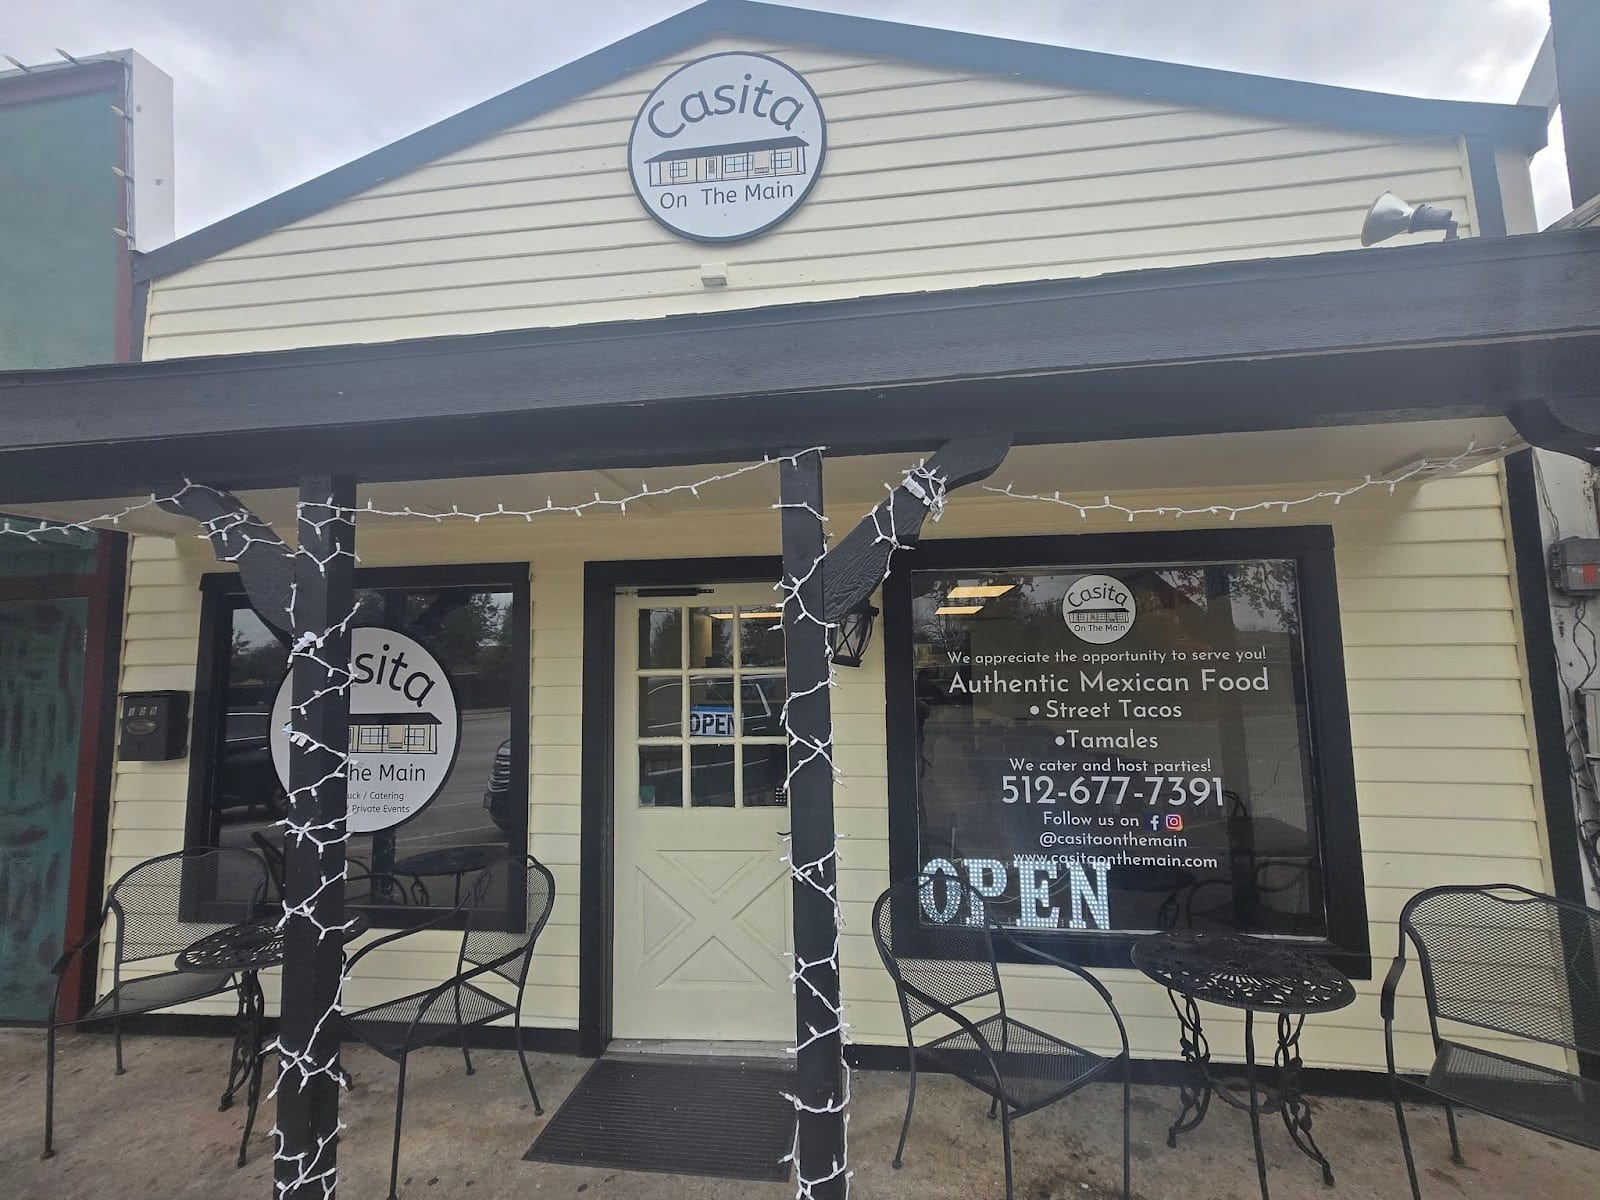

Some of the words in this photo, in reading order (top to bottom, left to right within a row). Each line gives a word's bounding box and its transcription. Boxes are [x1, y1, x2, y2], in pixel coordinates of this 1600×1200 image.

[648, 73, 804, 138] Casita
[660, 192, 687, 209] On
[701, 186, 738, 205] The
[745, 181, 793, 201] Main
[1068, 583, 1128, 607] Casita
[1074, 624, 1086, 632] On
[1088, 624, 1103, 632] The
[1105, 624, 1126, 632] Main
[947, 651, 970, 664] We
[975, 652, 1050, 666] appreciate
[1054, 649, 1078, 662] the
[1082, 649, 1167, 665] opportunity
[1171, 650, 1187, 661] to
[1192, 651, 1231, 661] serve
[1236, 645, 1267, 663] you!
[354, 643, 435, 708] sita
[948, 670, 1070, 694] Authentic
[1080, 670, 1189, 692] Mexican
[1201, 667, 1269, 691] Food
[1046, 700, 1111, 718] Street
[1118, 699, 1183, 718] Tacos
[1066, 728, 1159, 749] Tamales
[349, 764, 372, 782] he
[379, 763, 426, 782] Main
[1009, 758, 1034, 772] We
[1039, 760, 1077, 772] cater
[1082, 757, 1111, 772] and
[1117, 757, 1149, 772] host
[1154, 758, 1212, 775] parties!
[369, 791, 404, 802] Catering
[1002, 775, 1224, 806] 512-677-7391
[352, 804, 380, 813] Private
[383, 804, 410, 813] Events
[1043, 810, 1092, 825] Follow
[1098, 816, 1115, 826] us
[1120, 816, 1139, 827] on
[1039, 831, 1187, 848] @casitaonthemain
[1013, 850, 1218, 868] www.casitaonthemain.com
[919, 858, 1111, 930] OPEN
